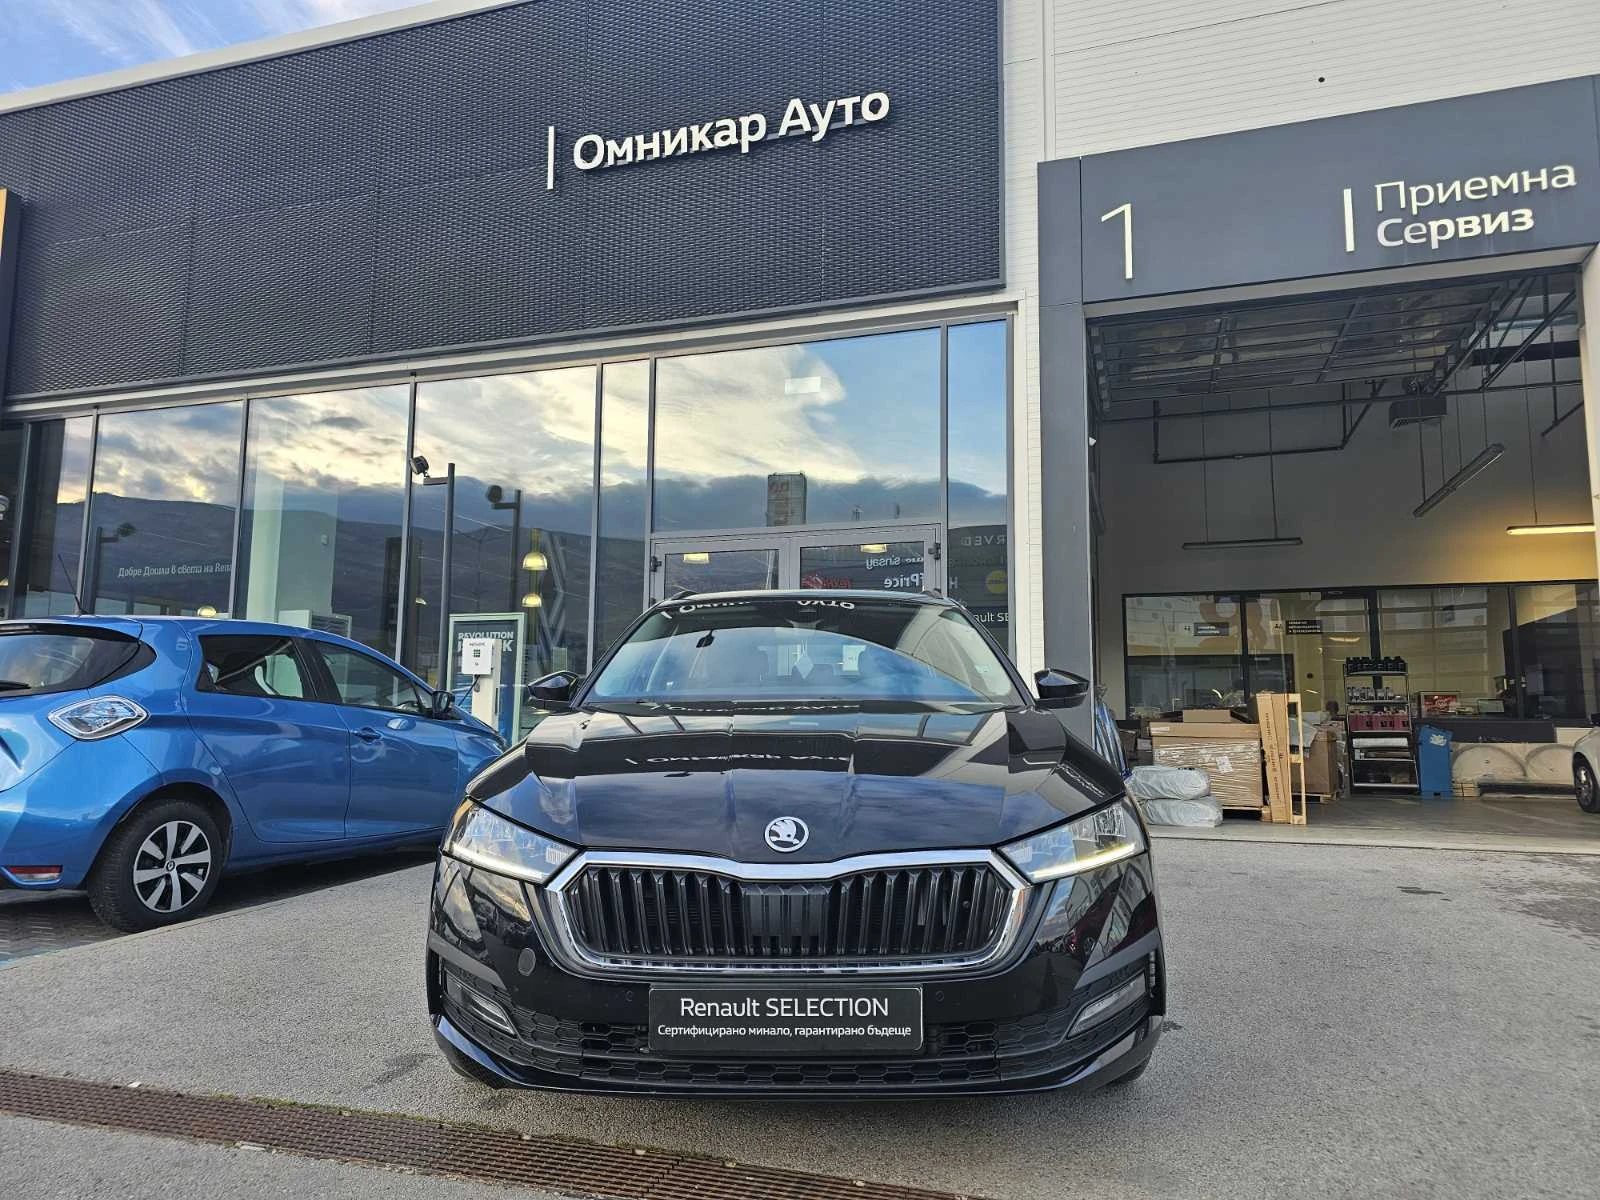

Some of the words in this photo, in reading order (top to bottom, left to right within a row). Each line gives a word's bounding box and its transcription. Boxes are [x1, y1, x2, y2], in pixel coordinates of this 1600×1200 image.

[573, 112, 767, 171] Омникар
[778, 91, 891, 142] Ауто
[1374, 163, 1577, 216] Приемна
[1100, 203, 1134, 280] 1
[1376, 207, 1534, 250] Сервиз
[658, 1024, 747, 1037] Сертифицирано
[748, 1025, 792, 1037] минало,
[794, 1025, 865, 1037] гарантирано
[867, 1024, 912, 1037] бъдеще
[680, 997, 760, 1017] Renault
[765, 997, 889, 1017] SELECTION
